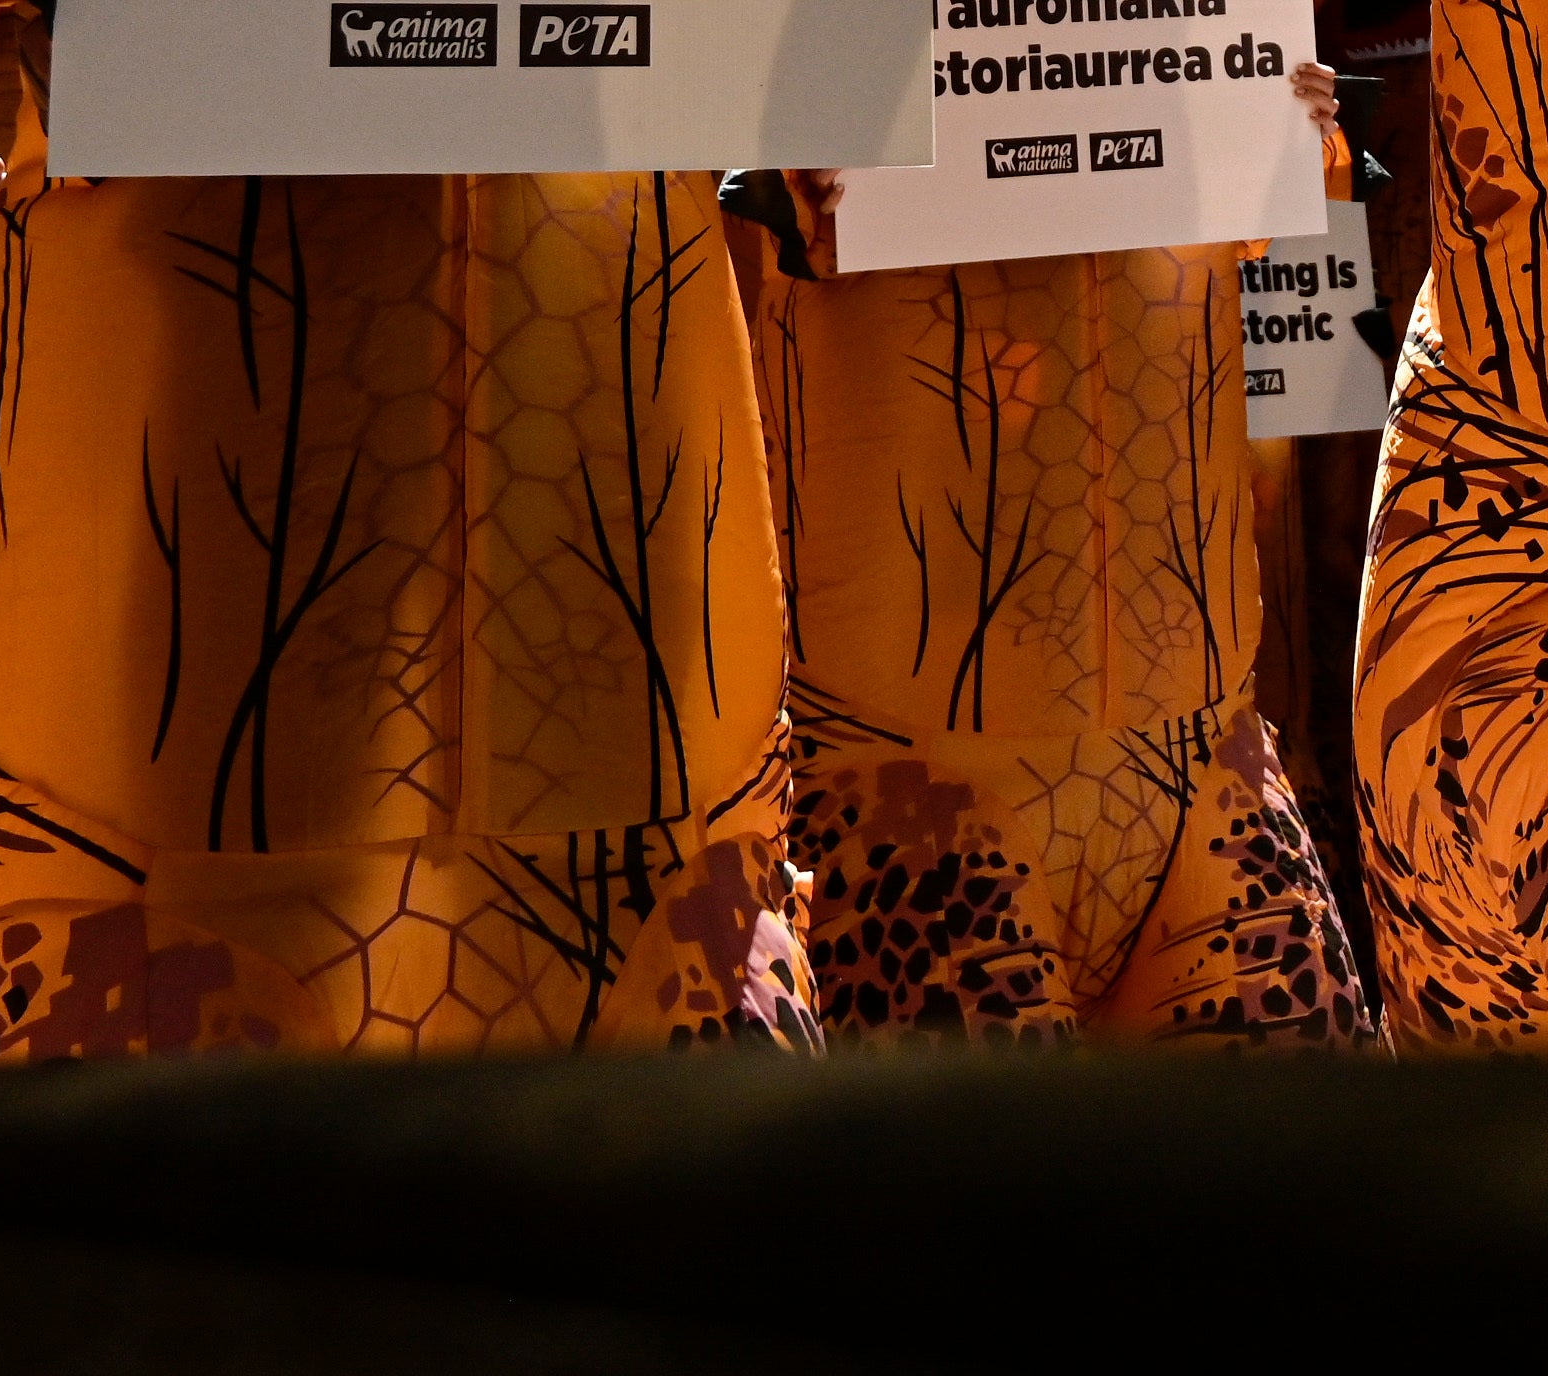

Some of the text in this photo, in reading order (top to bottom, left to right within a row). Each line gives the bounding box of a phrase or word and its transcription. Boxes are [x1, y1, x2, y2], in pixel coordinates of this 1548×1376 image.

[387, 9, 487, 39] anima
[387, 35, 487, 61] naturalis
[1224, 32, 1283, 78] da
[1018, 140, 1072, 160] anima
[1018, 154, 1073, 172] naturalis
[1239, 255, 1357, 297] ting Is
[1241, 305, 1334, 344] toric
